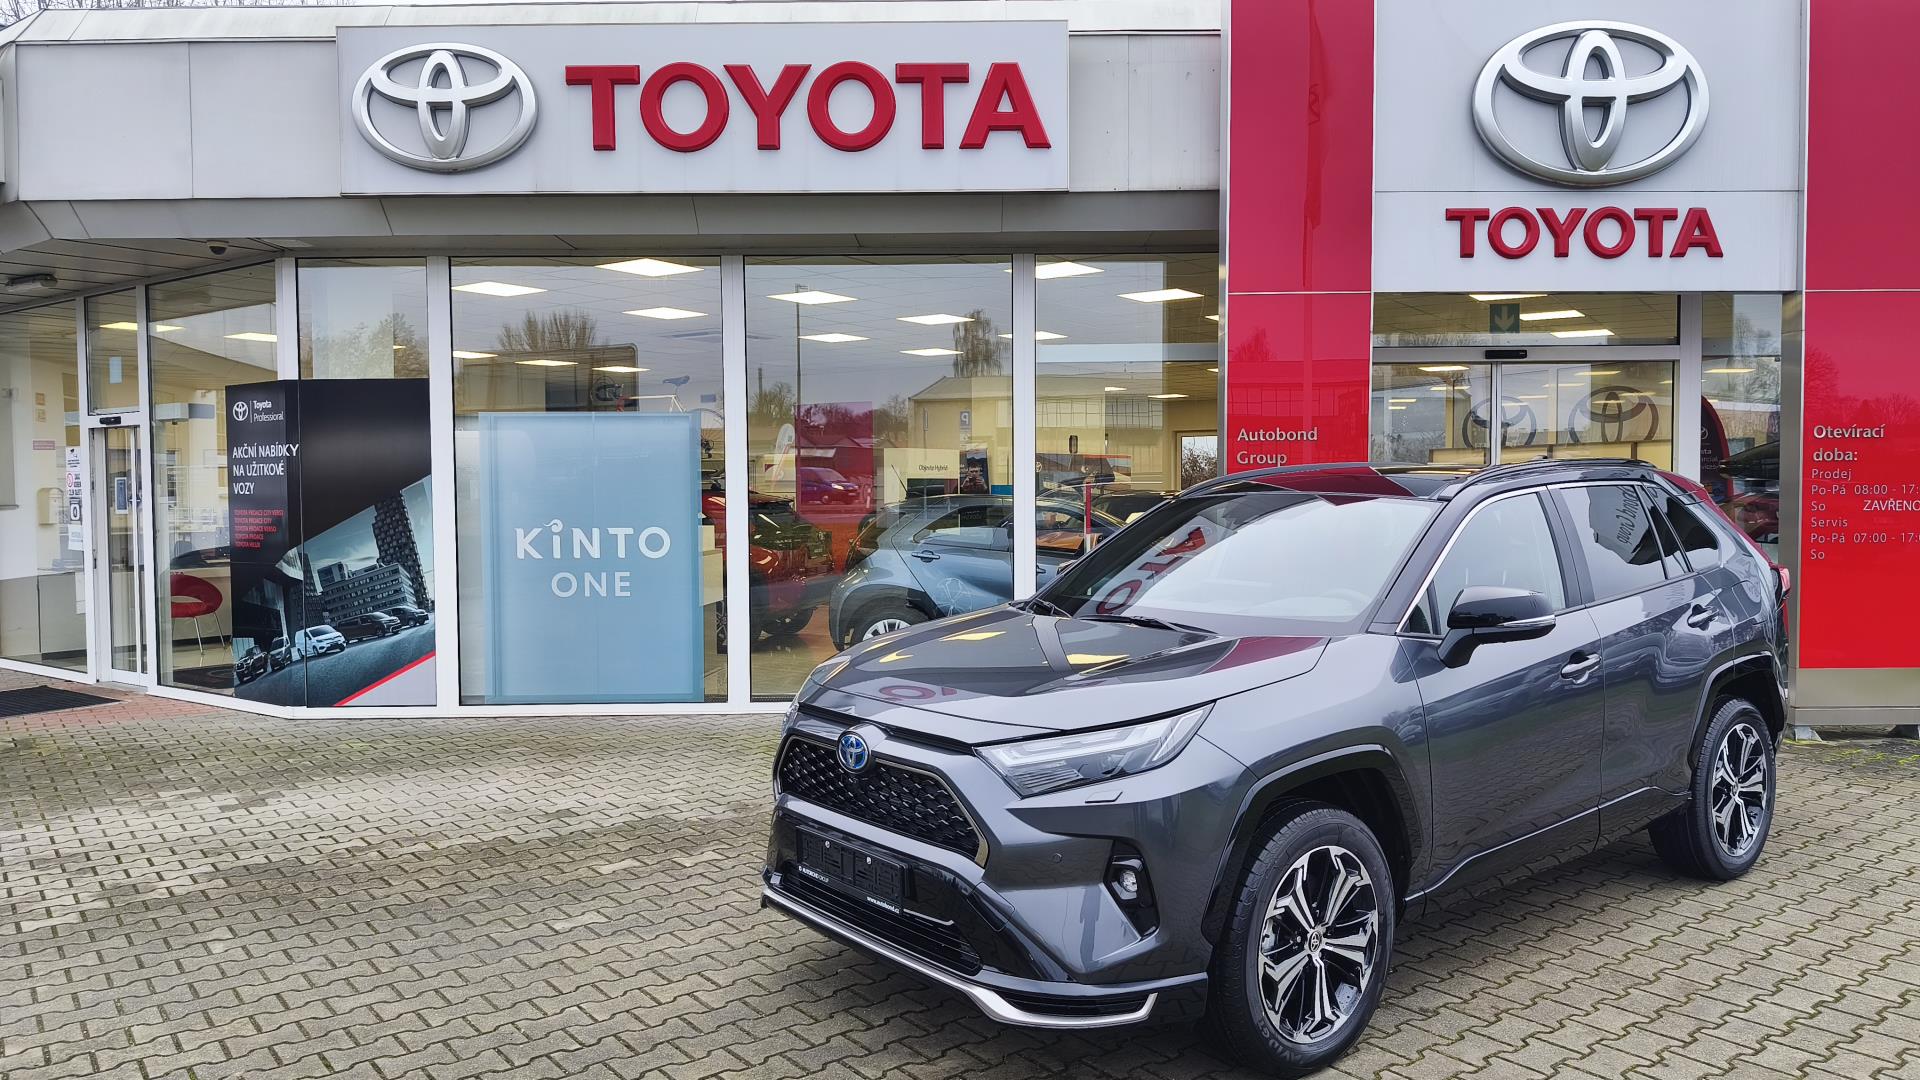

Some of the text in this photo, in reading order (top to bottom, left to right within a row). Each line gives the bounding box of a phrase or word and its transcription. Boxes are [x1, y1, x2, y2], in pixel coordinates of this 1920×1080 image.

[565, 61, 1052, 152] TOYOTA
[1445, 206, 1724, 259] TOYOTA
[253, 400, 272, 411] Toyota
[253, 411, 284, 422] Professional
[1237, 427, 1318, 441] Autobond
[1813, 424, 1886, 439] Otevírací
[232, 441, 299, 458] AKČNÍ NABÍDKY
[1813, 447, 1858, 461] doba:
[1236, 451, 1288, 467] Group
[233, 460, 285, 476] NA UŽITKOVÉ
[1811, 468, 1852, 481] Prodej
[233, 482, 255, 495] VOZY
[1811, 484, 1846, 495] Po-Pá
[1854, 484, 1888, 495] 08:00
[1811, 501, 1826, 511] So
[1811, 517, 1848, 527] Servis
[1811, 532, 1845, 543] Po-Pá
[1853, 533, 1887, 543] 07:00
[1811, 549, 1825, 559] So
[551, 571, 631, 598] ONE
